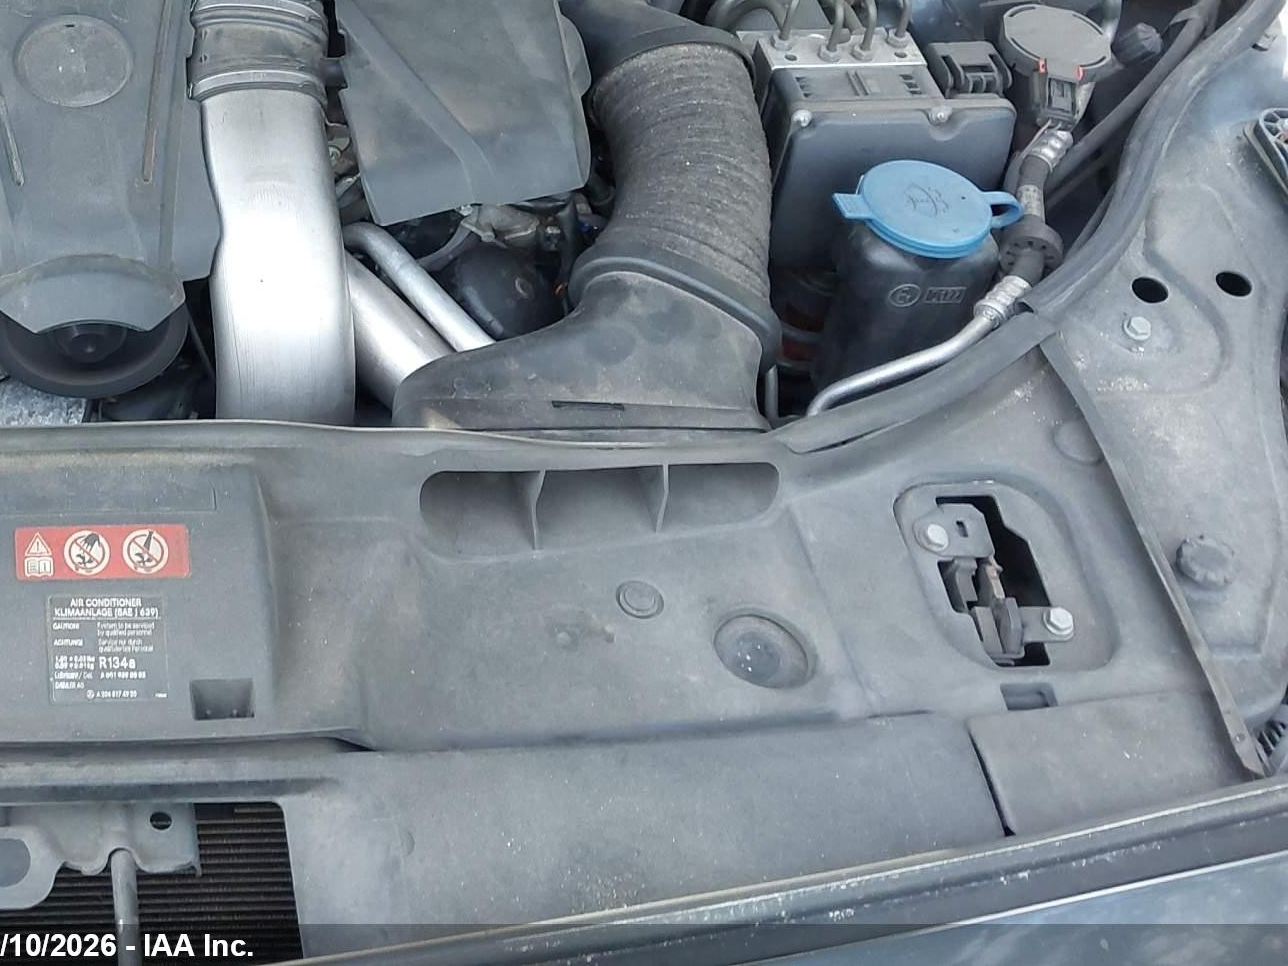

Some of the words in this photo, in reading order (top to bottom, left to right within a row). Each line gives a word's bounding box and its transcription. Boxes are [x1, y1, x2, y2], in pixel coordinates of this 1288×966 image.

[70, 598, 84, 608] AIR
[85, 598, 142, 608] CONDITIONER
[54, 607, 113, 617] KLIMAANLAGE
[98, 656, 136, 669] R134a
